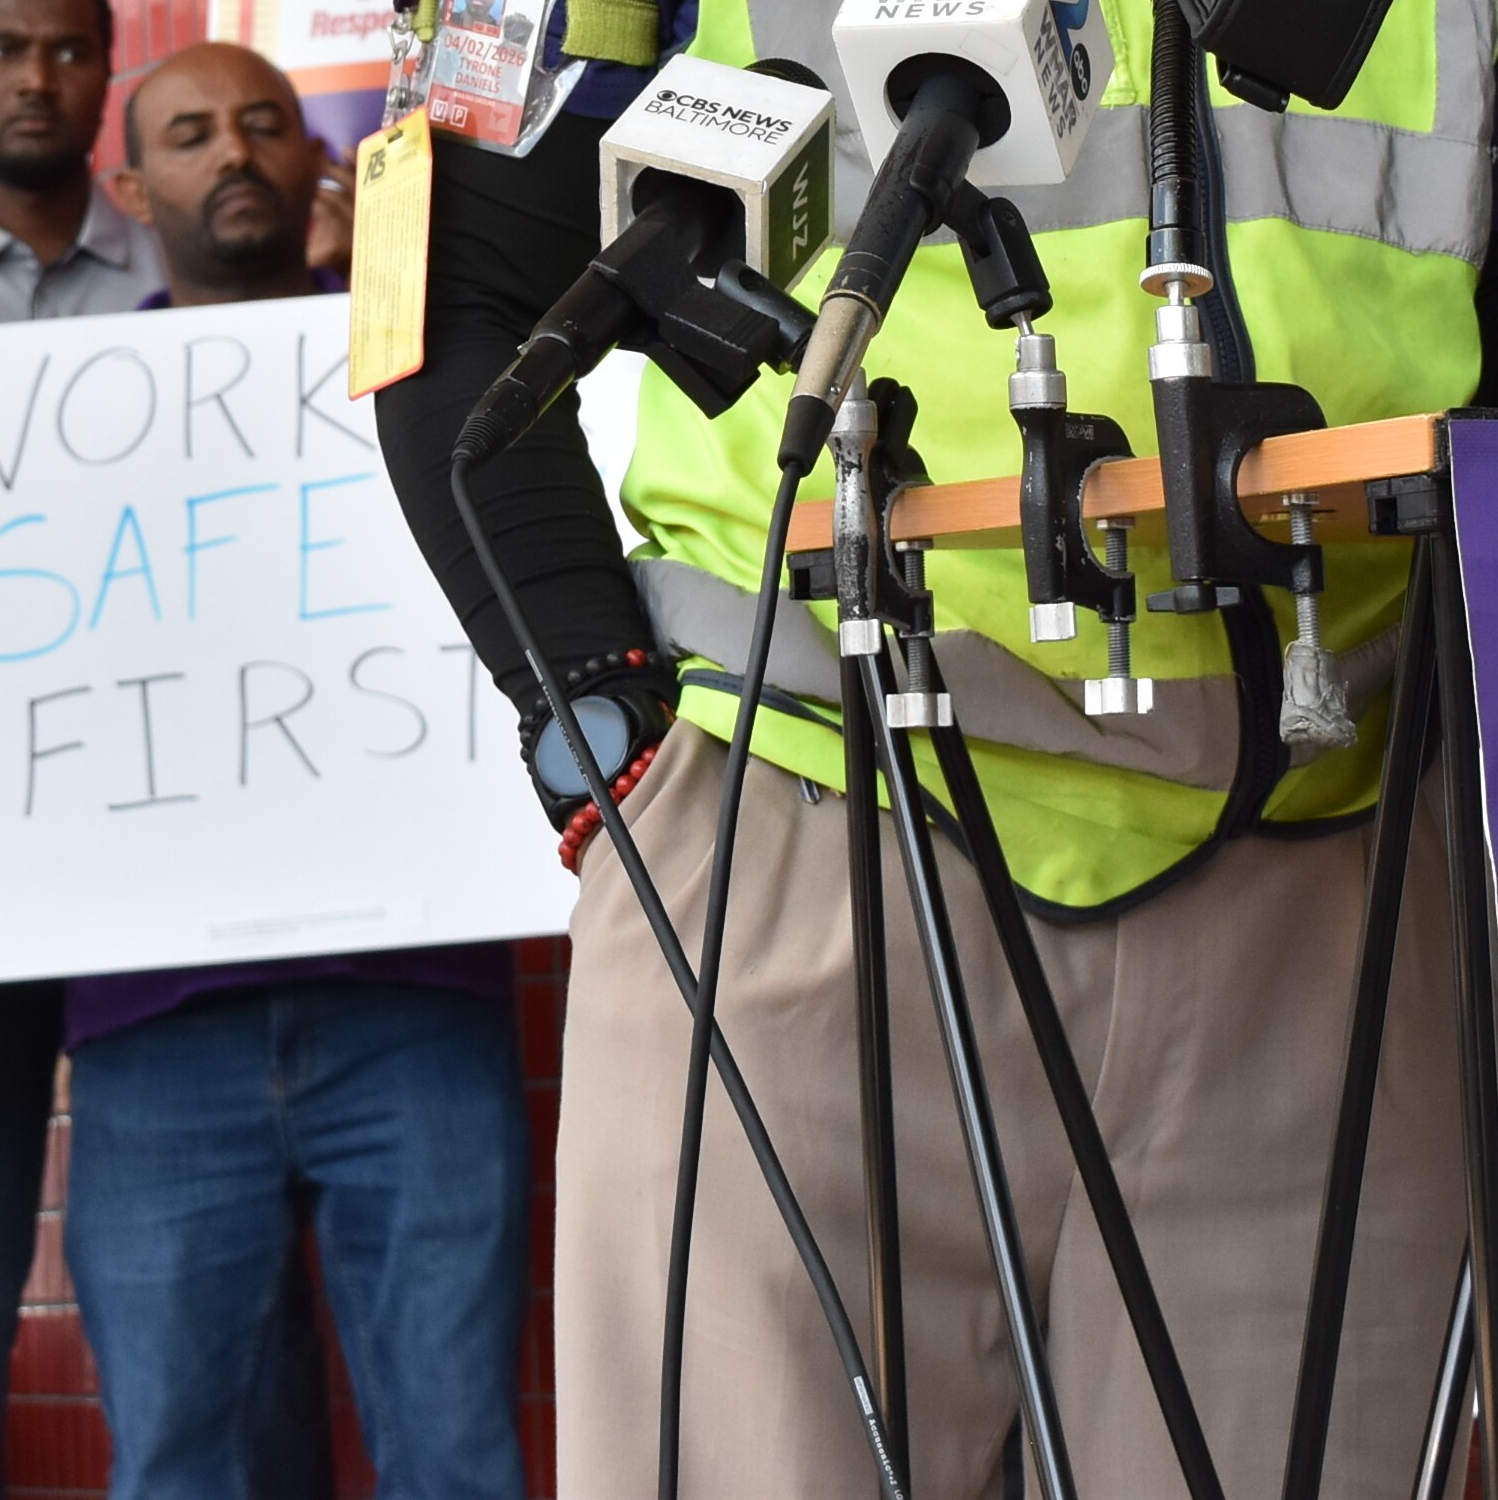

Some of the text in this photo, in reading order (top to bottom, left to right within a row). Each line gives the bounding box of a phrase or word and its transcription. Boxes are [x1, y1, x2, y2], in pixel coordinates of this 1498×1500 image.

[874, 1, 986, 20] NEWS
[455, 71, 501, 94] DANIELS
[459, 56, 502, 78] TYRONE
[1034, 35, 1066, 140] NEWS
[1040, 6, 1078, 135] WMAR
[1073, 50, 1088, 94] abc
[643, 100, 784, 145] BALTIMORE
[676, 94, 794, 133] CBS NEWS
